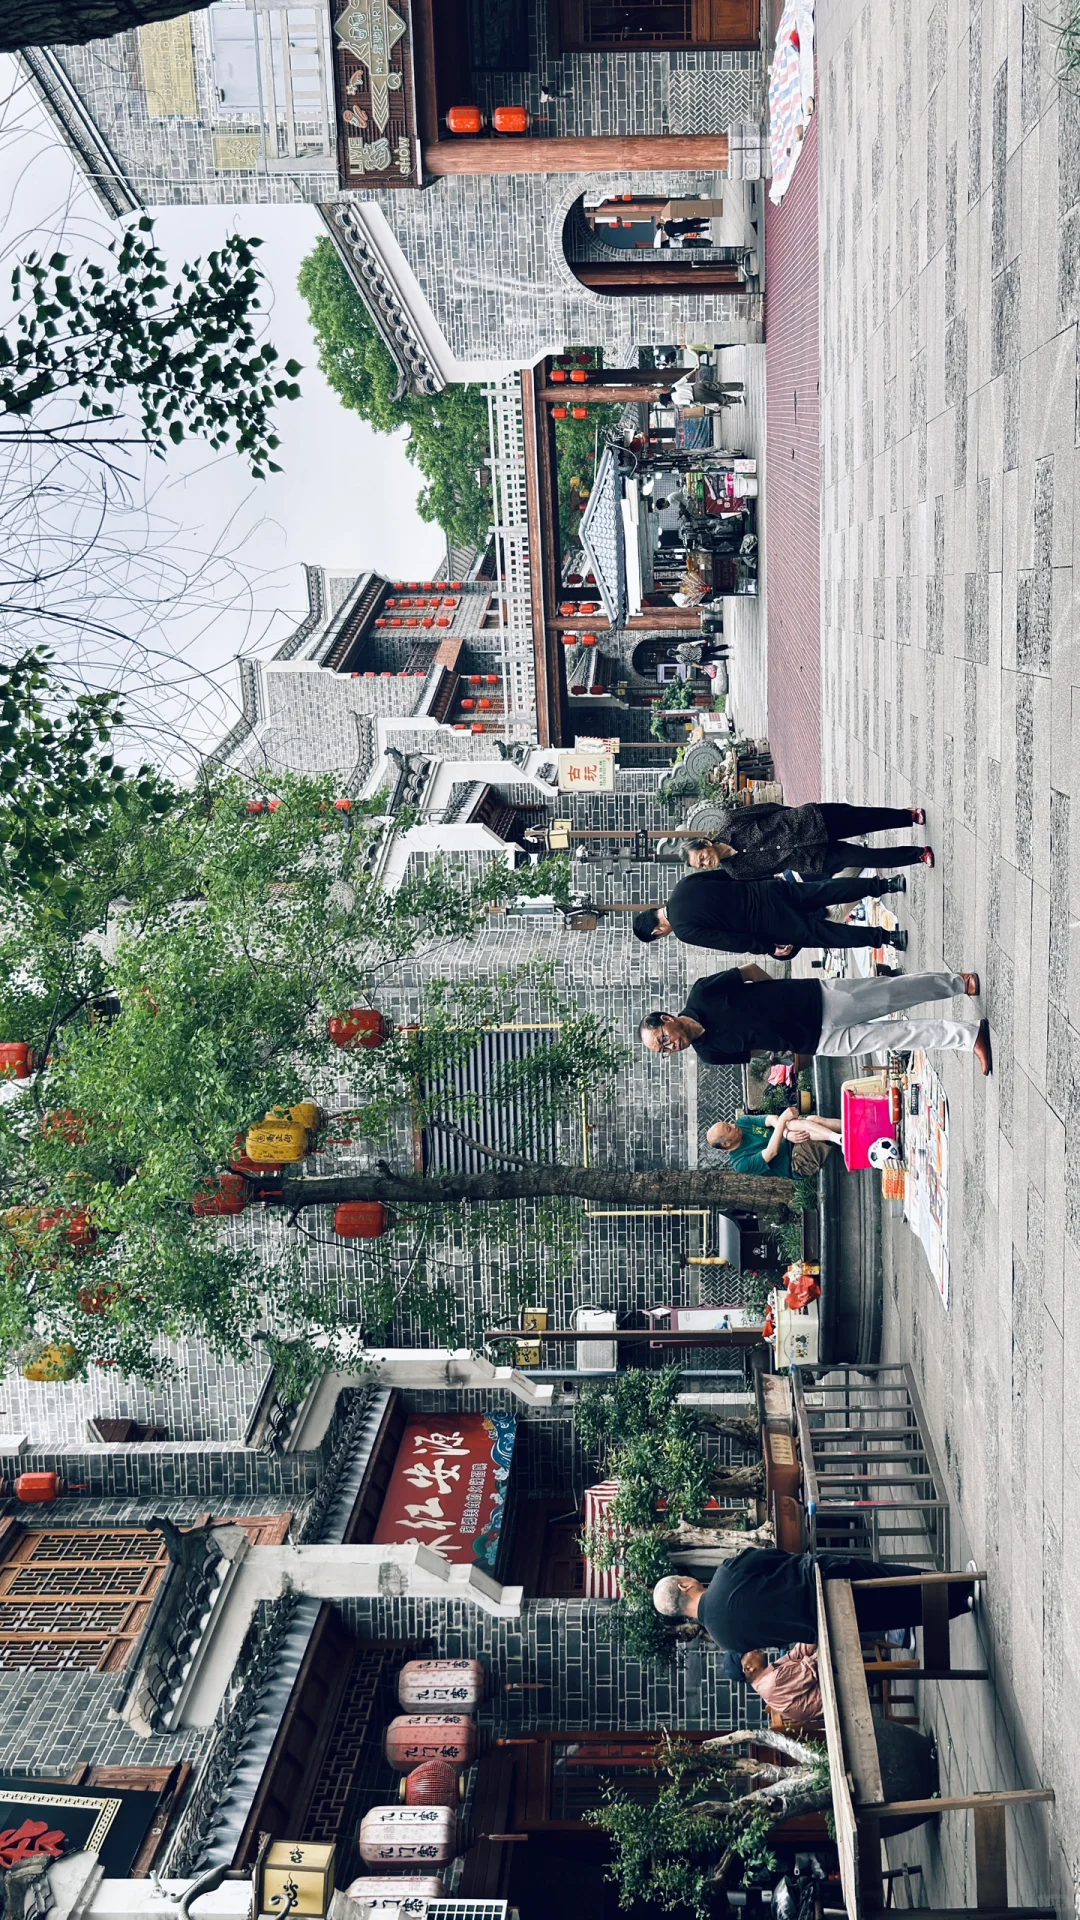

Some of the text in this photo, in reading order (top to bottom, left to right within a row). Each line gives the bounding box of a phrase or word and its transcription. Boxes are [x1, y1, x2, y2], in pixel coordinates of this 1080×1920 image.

[172, 20, 188, 70] FRIDAY
[159, 55, 173, 96] Black
[348, 136, 365, 174] LIVE
[398, 136, 412, 174] SHOW
[567, 764, 598, 782] 古玩
[417, 1660, 470, 1669] 九门寨
[415, 1687, 469, 1700] 九门寨
[405, 1715, 462, 1724] 九门寨
[403, 1745, 460, 1758] 九门寨
[380, 1810, 438, 1822] 九门寨
[379, 1844, 439, 1858] 九门寨
